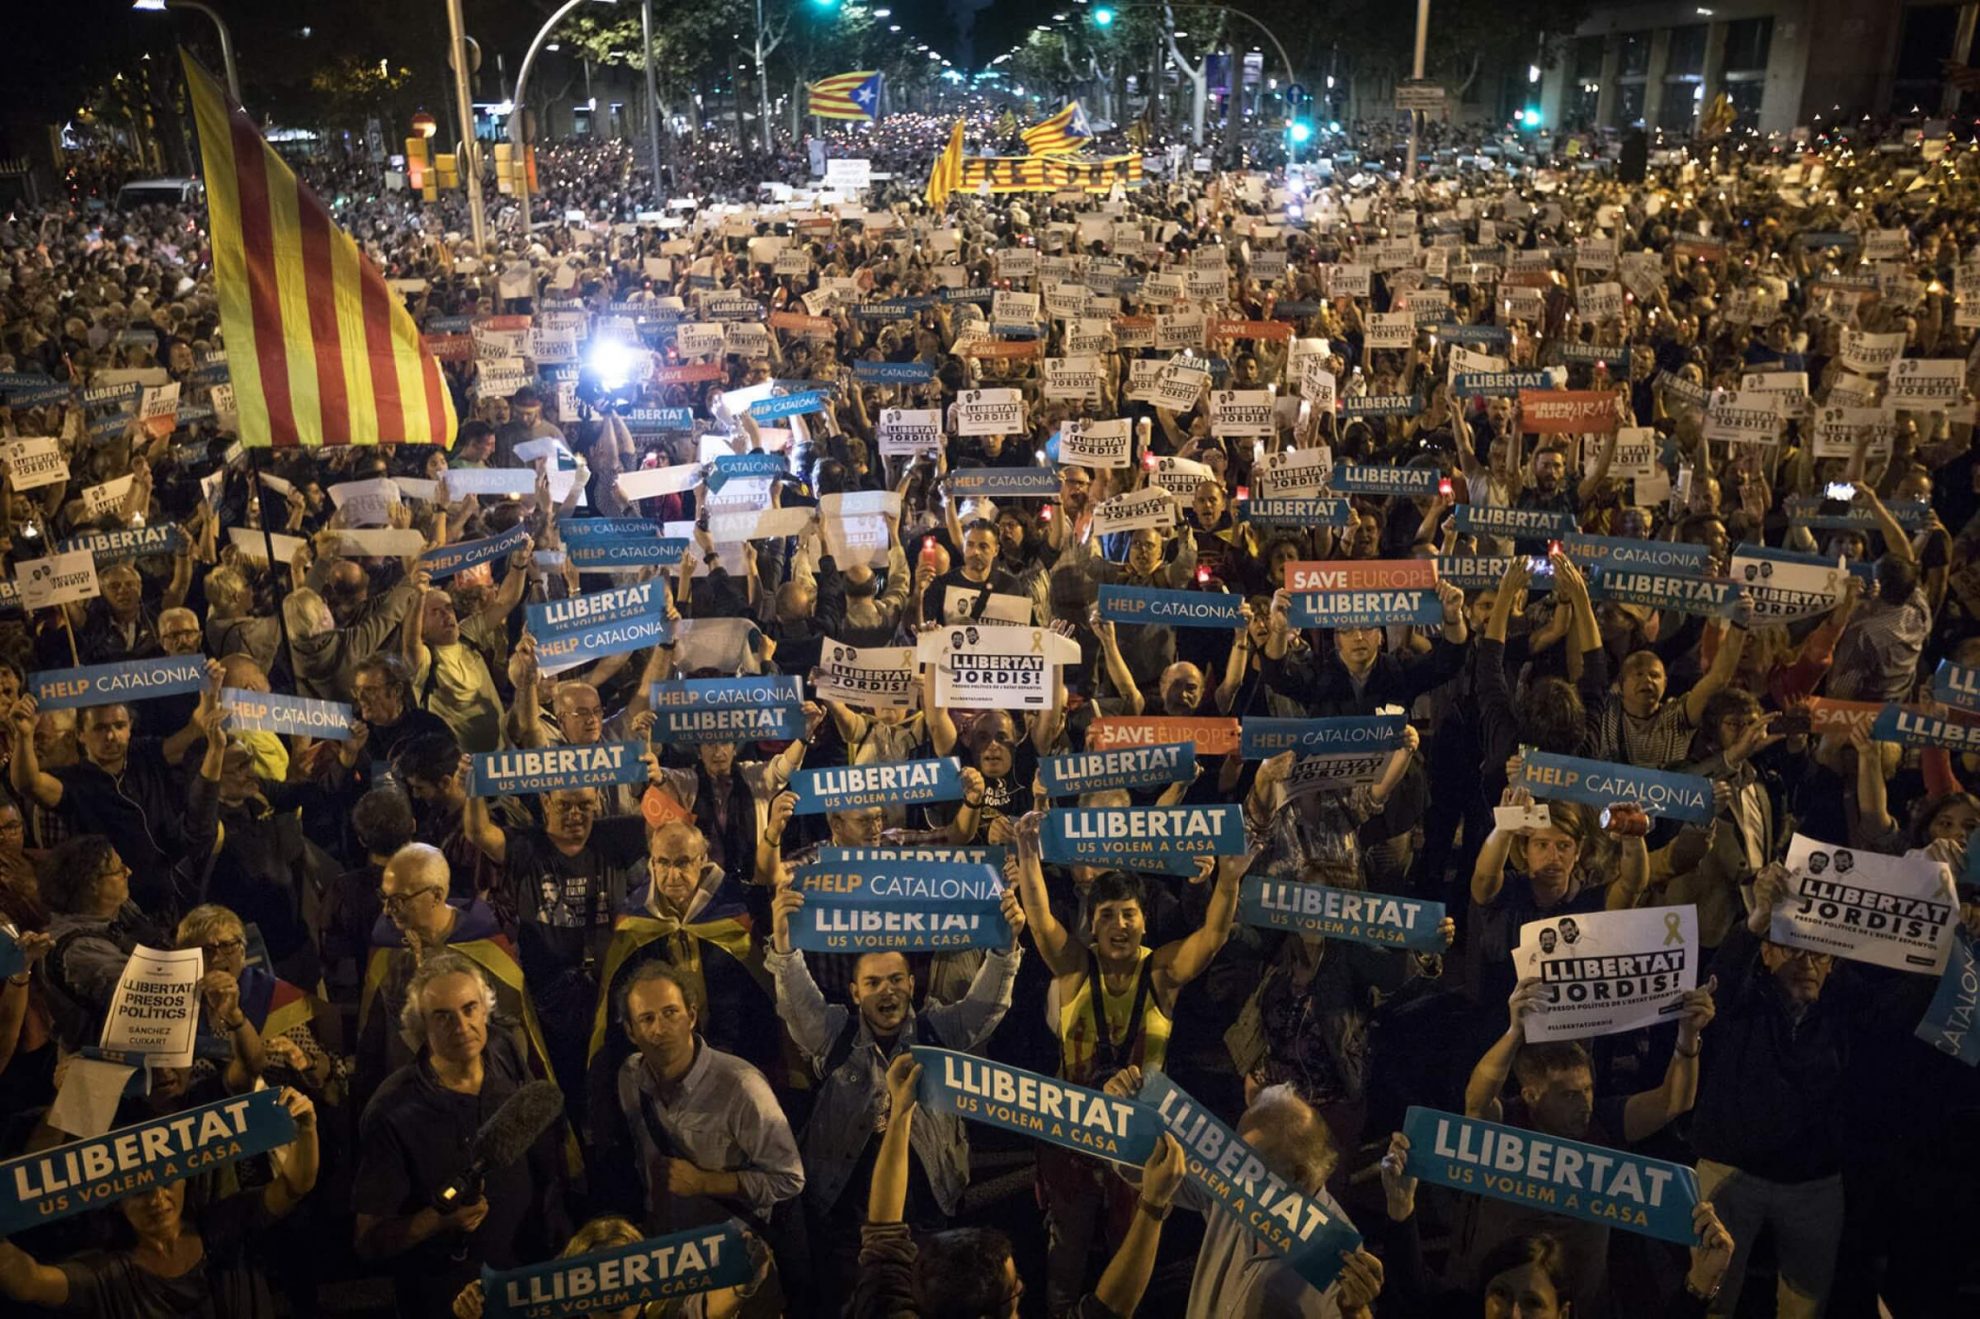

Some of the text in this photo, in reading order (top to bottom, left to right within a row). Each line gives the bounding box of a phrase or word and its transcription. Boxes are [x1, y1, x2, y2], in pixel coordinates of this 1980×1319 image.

[1220, 324, 1246, 334] SAVE
[972, 346, 996, 354] SAVE
[1563, 344, 1622, 358] LLIBERTAT
[658, 370, 682, 382] SAVE
[880, 368, 930, 378] CATALONIA
[1464, 372, 1543, 388] LLIBERTAT
[84, 382, 137, 400] LLIBERTAT
[966, 404, 1017, 413] LLIBERTAT
[1220, 406, 1270, 415] LLIBERTAT
[1348, 396, 1413, 410] LLIBERTAT
[968, 413, 1016, 422] JORDIS!
[1220, 414, 1270, 422] JORDIS!
[1716, 418, 1774, 430] JORDIS!
[887, 434, 936, 442] JORDIS!
[1070, 436, 1126, 446] LLIBERTAT
[1070, 444, 1125, 454] JORDIS!
[18, 461, 60, 475] JORDIS!
[721, 462, 782, 472] CATALONIA
[1272, 466, 1327, 480] LLIBERTAT
[955, 475, 1054, 487] HELP CATALONIA
[1346, 468, 1432, 486] LLIBERTAT
[1104, 506, 1166, 521] JORDIS!
[1250, 501, 1338, 516] LLIBERTAT
[1468, 507, 1562, 530] LLIBERTAT
[593, 522, 656, 534] CATALONIA
[432, 531, 528, 571] HELP CATALONIA
[572, 546, 683, 560] HELP CATALONIA
[1570, 544, 1701, 568] HELP CATALONIA
[1294, 570, 1432, 589] SAVE EUROPE
[1603, 572, 1729, 604] LLIBERTAT
[545, 584, 652, 624] LLIBERTAT
[1108, 598, 1236, 619] HELP CATALONIA
[1306, 592, 1422, 614] LLIBERTAT
[1630, 594, 1668, 606] VOLEM
[620, 606, 646, 617] CASA
[1314, 616, 1328, 624] US
[1333, 616, 1370, 624] VOLEM
[1386, 614, 1414, 622] CASA
[541, 622, 664, 657] HELP CATALONIA
[953, 655, 1043, 670] LLIBERTAT
[832, 664, 912, 681] LLIBERTAT
[953, 670, 1040, 684] JORDIS!
[40, 667, 200, 700] HELP CATALONIA
[832, 676, 908, 692] JORDIS!
[658, 687, 797, 706] HELP CATALONIA
[232, 702, 348, 728] HELP CATALONIA
[670, 708, 786, 732] LLIBERTAT
[697, 731, 735, 740] VOLEM
[750, 728, 778, 738] CASA
[1102, 726, 1231, 744] SAVE EUROPE
[1252, 726, 1394, 748] HELP CATALONIA
[487, 746, 624, 779] LLIBERTAT
[1054, 746, 1181, 781] LLIBERTAT
[499, 772, 617, 790] US VOLEM A CASA
[813, 762, 941, 796] LLIBERTAT
[1066, 770, 1174, 792] US VOLEM A CASA
[1526, 764, 1705, 808] HELP CATALONIA
[824, 788, 934, 808] US VOLEM A CASA
[1064, 810, 1226, 838] LLIBERTAT
[1076, 840, 1216, 853] US VOLEM A CASA
[803, 874, 1003, 900] HELP CATALONIA
[1261, 882, 1422, 930] LLIBERTAT
[1803, 880, 1950, 924] LLIBERTAT
[1270, 912, 1406, 944] US VOLEM A CASA
[1794, 914, 1822, 926] PRESOS
[1798, 898, 1939, 942] JORDIS!
[827, 934, 972, 947] US VOLEM A CASA
[1544, 952, 1684, 982] LLIBERTAT
[123, 979, 194, 994] LLIBERTAT
[1548, 972, 1680, 1004] JORDIS!
[125, 993, 185, 1007] PRESOS
[1548, 1004, 1576, 1012] PRESOS
[1612, 1000, 1621, 1008] DE
[118, 1004, 186, 1019] POLÍTICS
[945, 1056, 1134, 1138] LLIBERTAT
[957, 1096, 1118, 1154] US VOLEM A CASA
[14, 1100, 250, 1202] LLIBERTAT
[1157, 1089, 1329, 1242] LLIBERTAT
[1434, 1118, 1673, 1207] LLIBERTAT
[39, 1142, 242, 1216] US VOLEM A CASA
[1448, 1165, 1648, 1226] US VOLEM A CASA
[1232, 1198, 1292, 1254] A CASA
[507, 1234, 726, 1308] LLIBERTAT
[528, 1275, 713, 1318] US VOLEM A CASA
